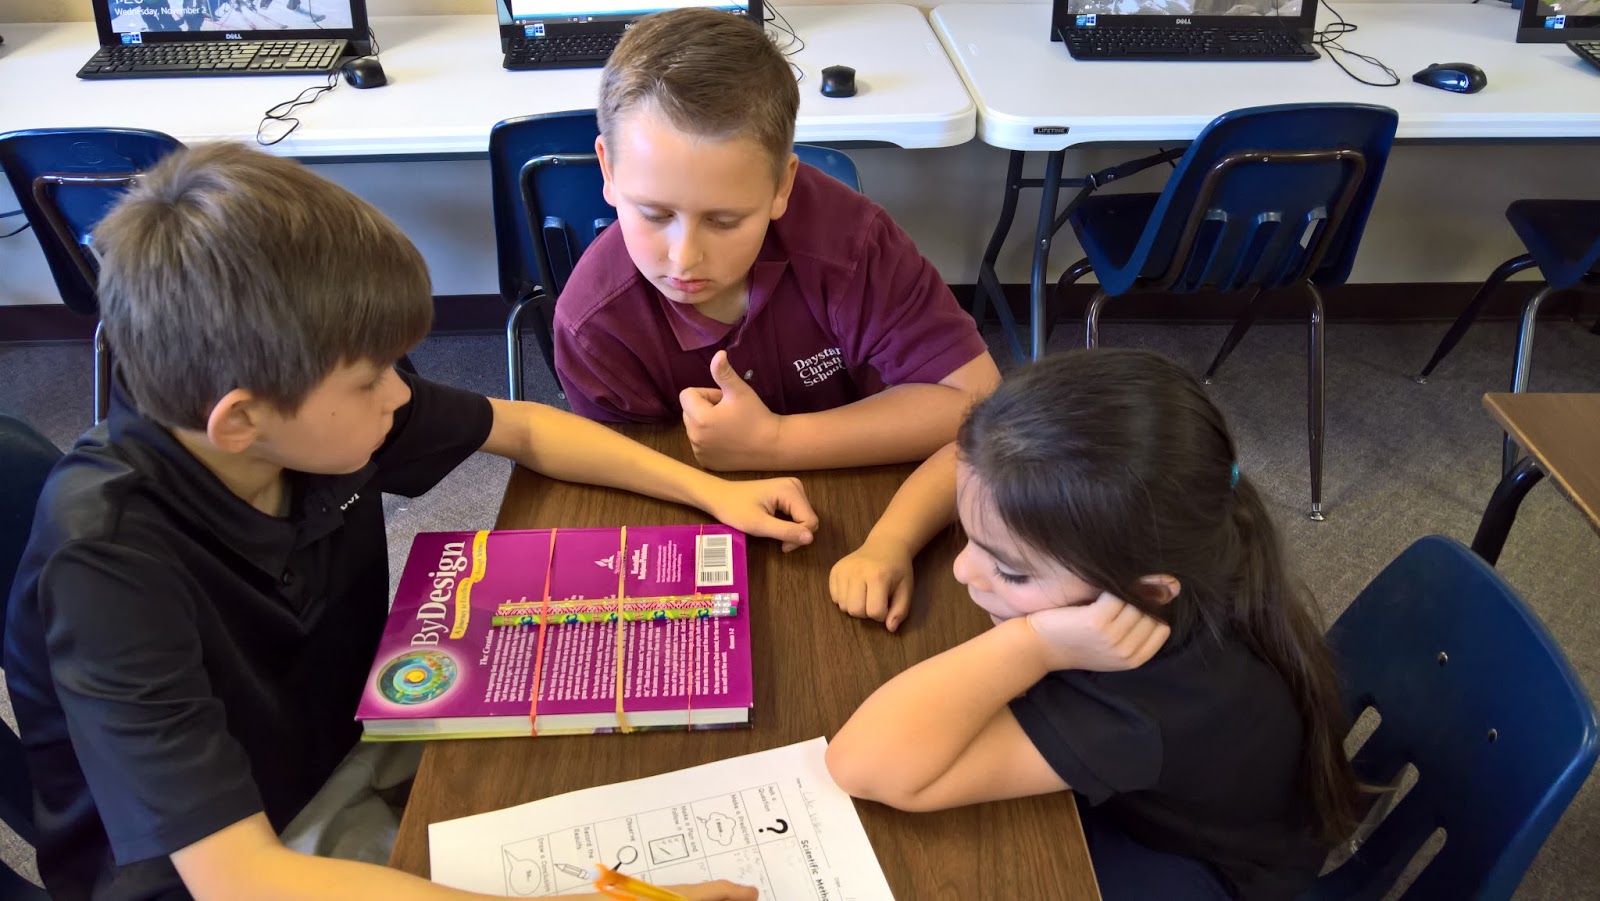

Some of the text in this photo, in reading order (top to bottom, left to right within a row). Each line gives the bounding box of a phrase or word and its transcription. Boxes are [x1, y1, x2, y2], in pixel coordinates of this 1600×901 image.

[115, 7, 159, 17] Wednesday,
[161, 7, 198, 15] November
[793, 347, 841, 371] Daystar
[758, 787, 770, 811] Question
[671, 807, 679, 825] Follow
[731, 794, 739, 809] Make
[738, 815, 751, 845] Prediction
[574, 828, 582, 850] Results
[584, 826, 592, 847] Record
[625, 817, 636, 842] Observe
[681, 805, 689, 821] Make
[690, 841, 699, 852] and
[541, 860, 551, 892] Conclusion
[801, 839, 819, 875] Scientific
[815, 878, 829, 901] Metho
